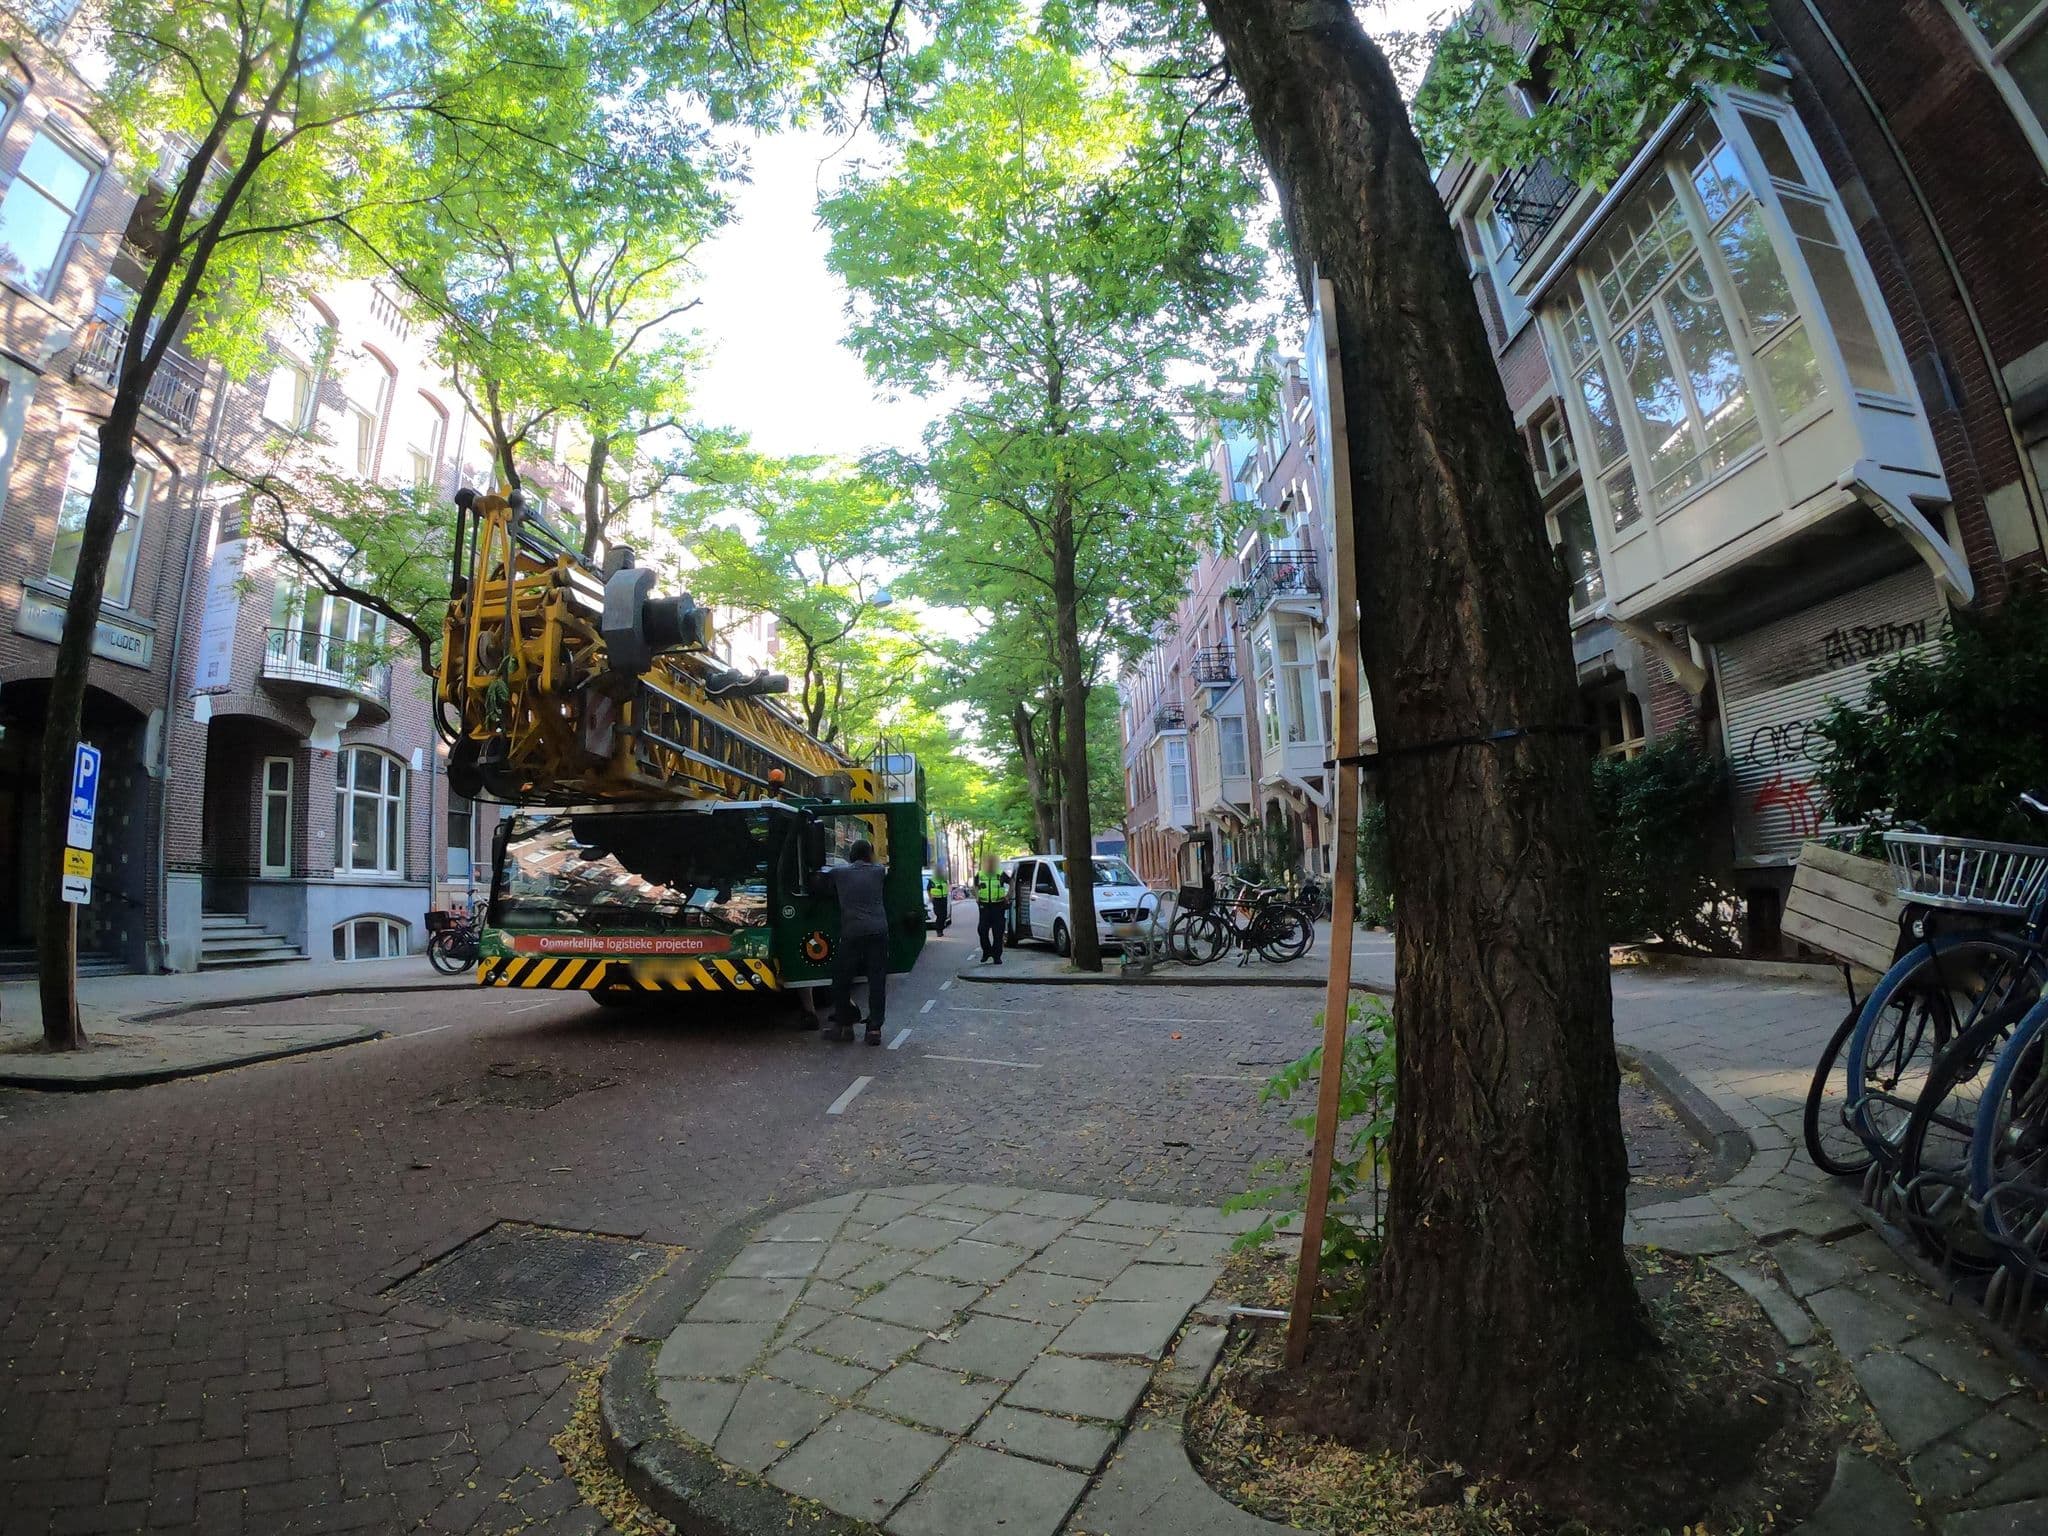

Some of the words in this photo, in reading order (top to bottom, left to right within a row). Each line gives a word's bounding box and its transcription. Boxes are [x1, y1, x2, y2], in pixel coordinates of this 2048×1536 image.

[78, 751, 95, 788] P
[606, 937, 653, 951] logistieke
[655, 938, 703, 952] projecten
